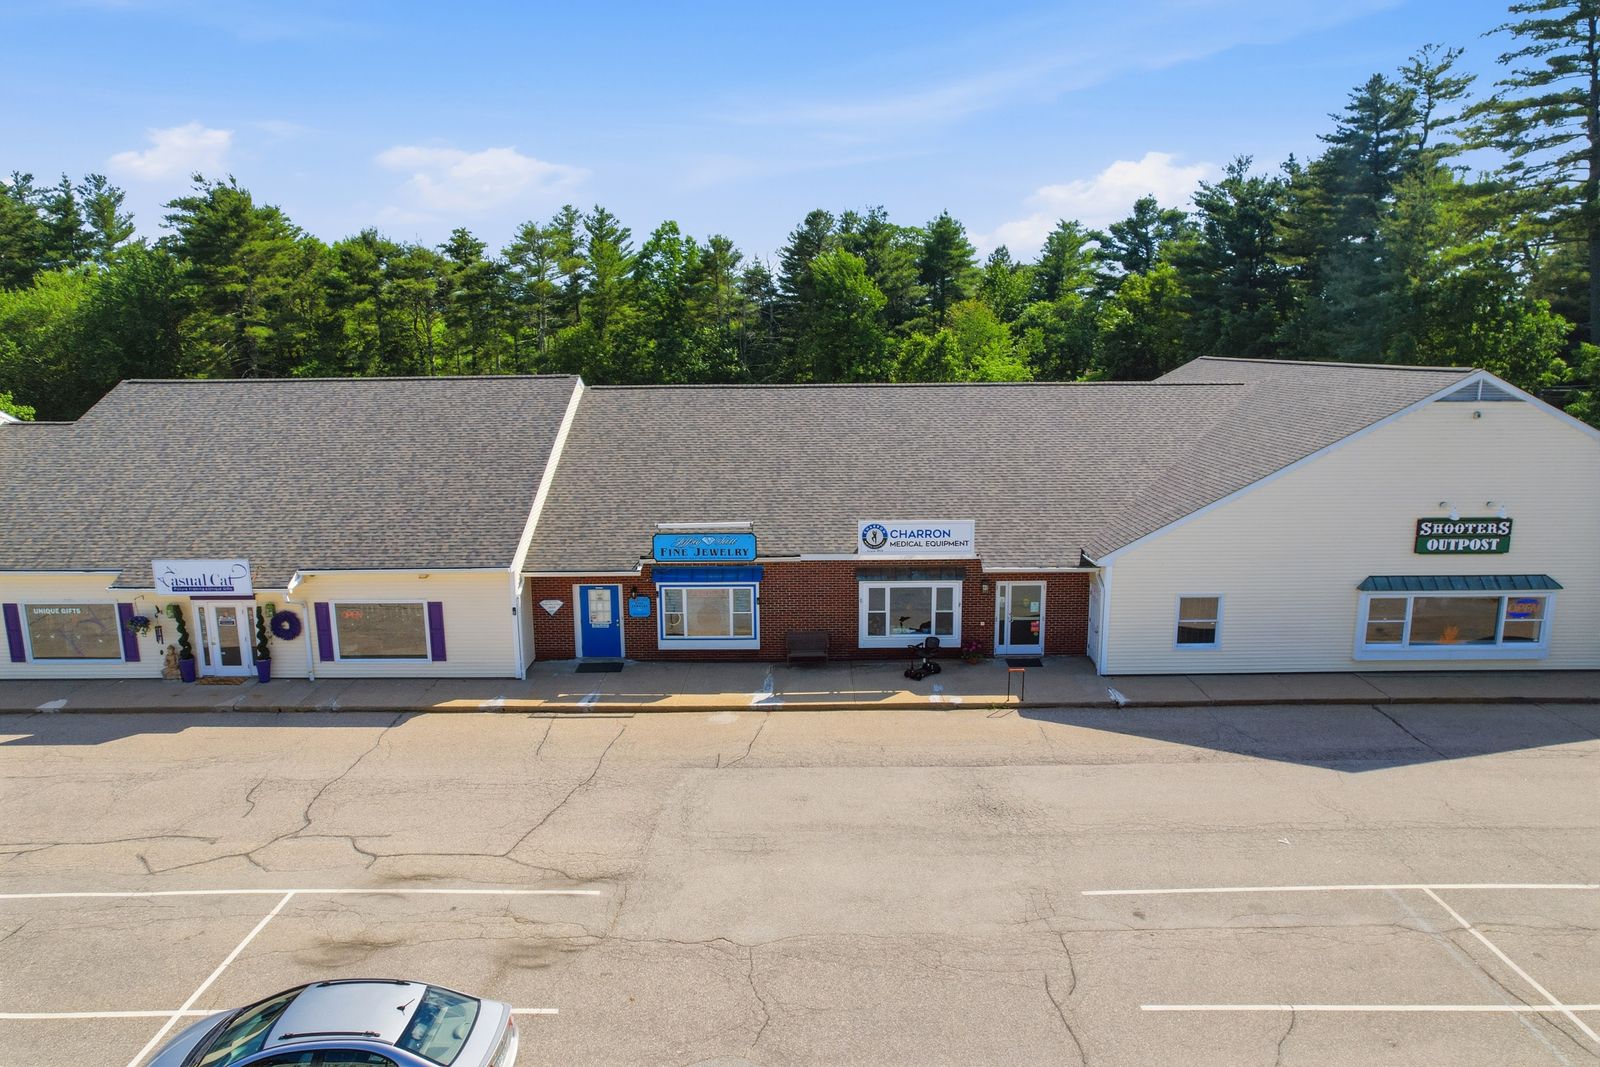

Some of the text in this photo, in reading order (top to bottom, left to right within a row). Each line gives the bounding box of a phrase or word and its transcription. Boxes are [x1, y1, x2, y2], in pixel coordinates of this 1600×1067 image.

[1420, 522, 1510, 535] SHOOTERS
[890, 529, 951, 539] CHARRON
[890, 540, 923, 548] MEDICAL
[926, 540, 969, 548] EQUIPMENT
[1427, 538, 1500, 551] OUTPOST
[661, 547, 749, 557] FINE JEWELRY
